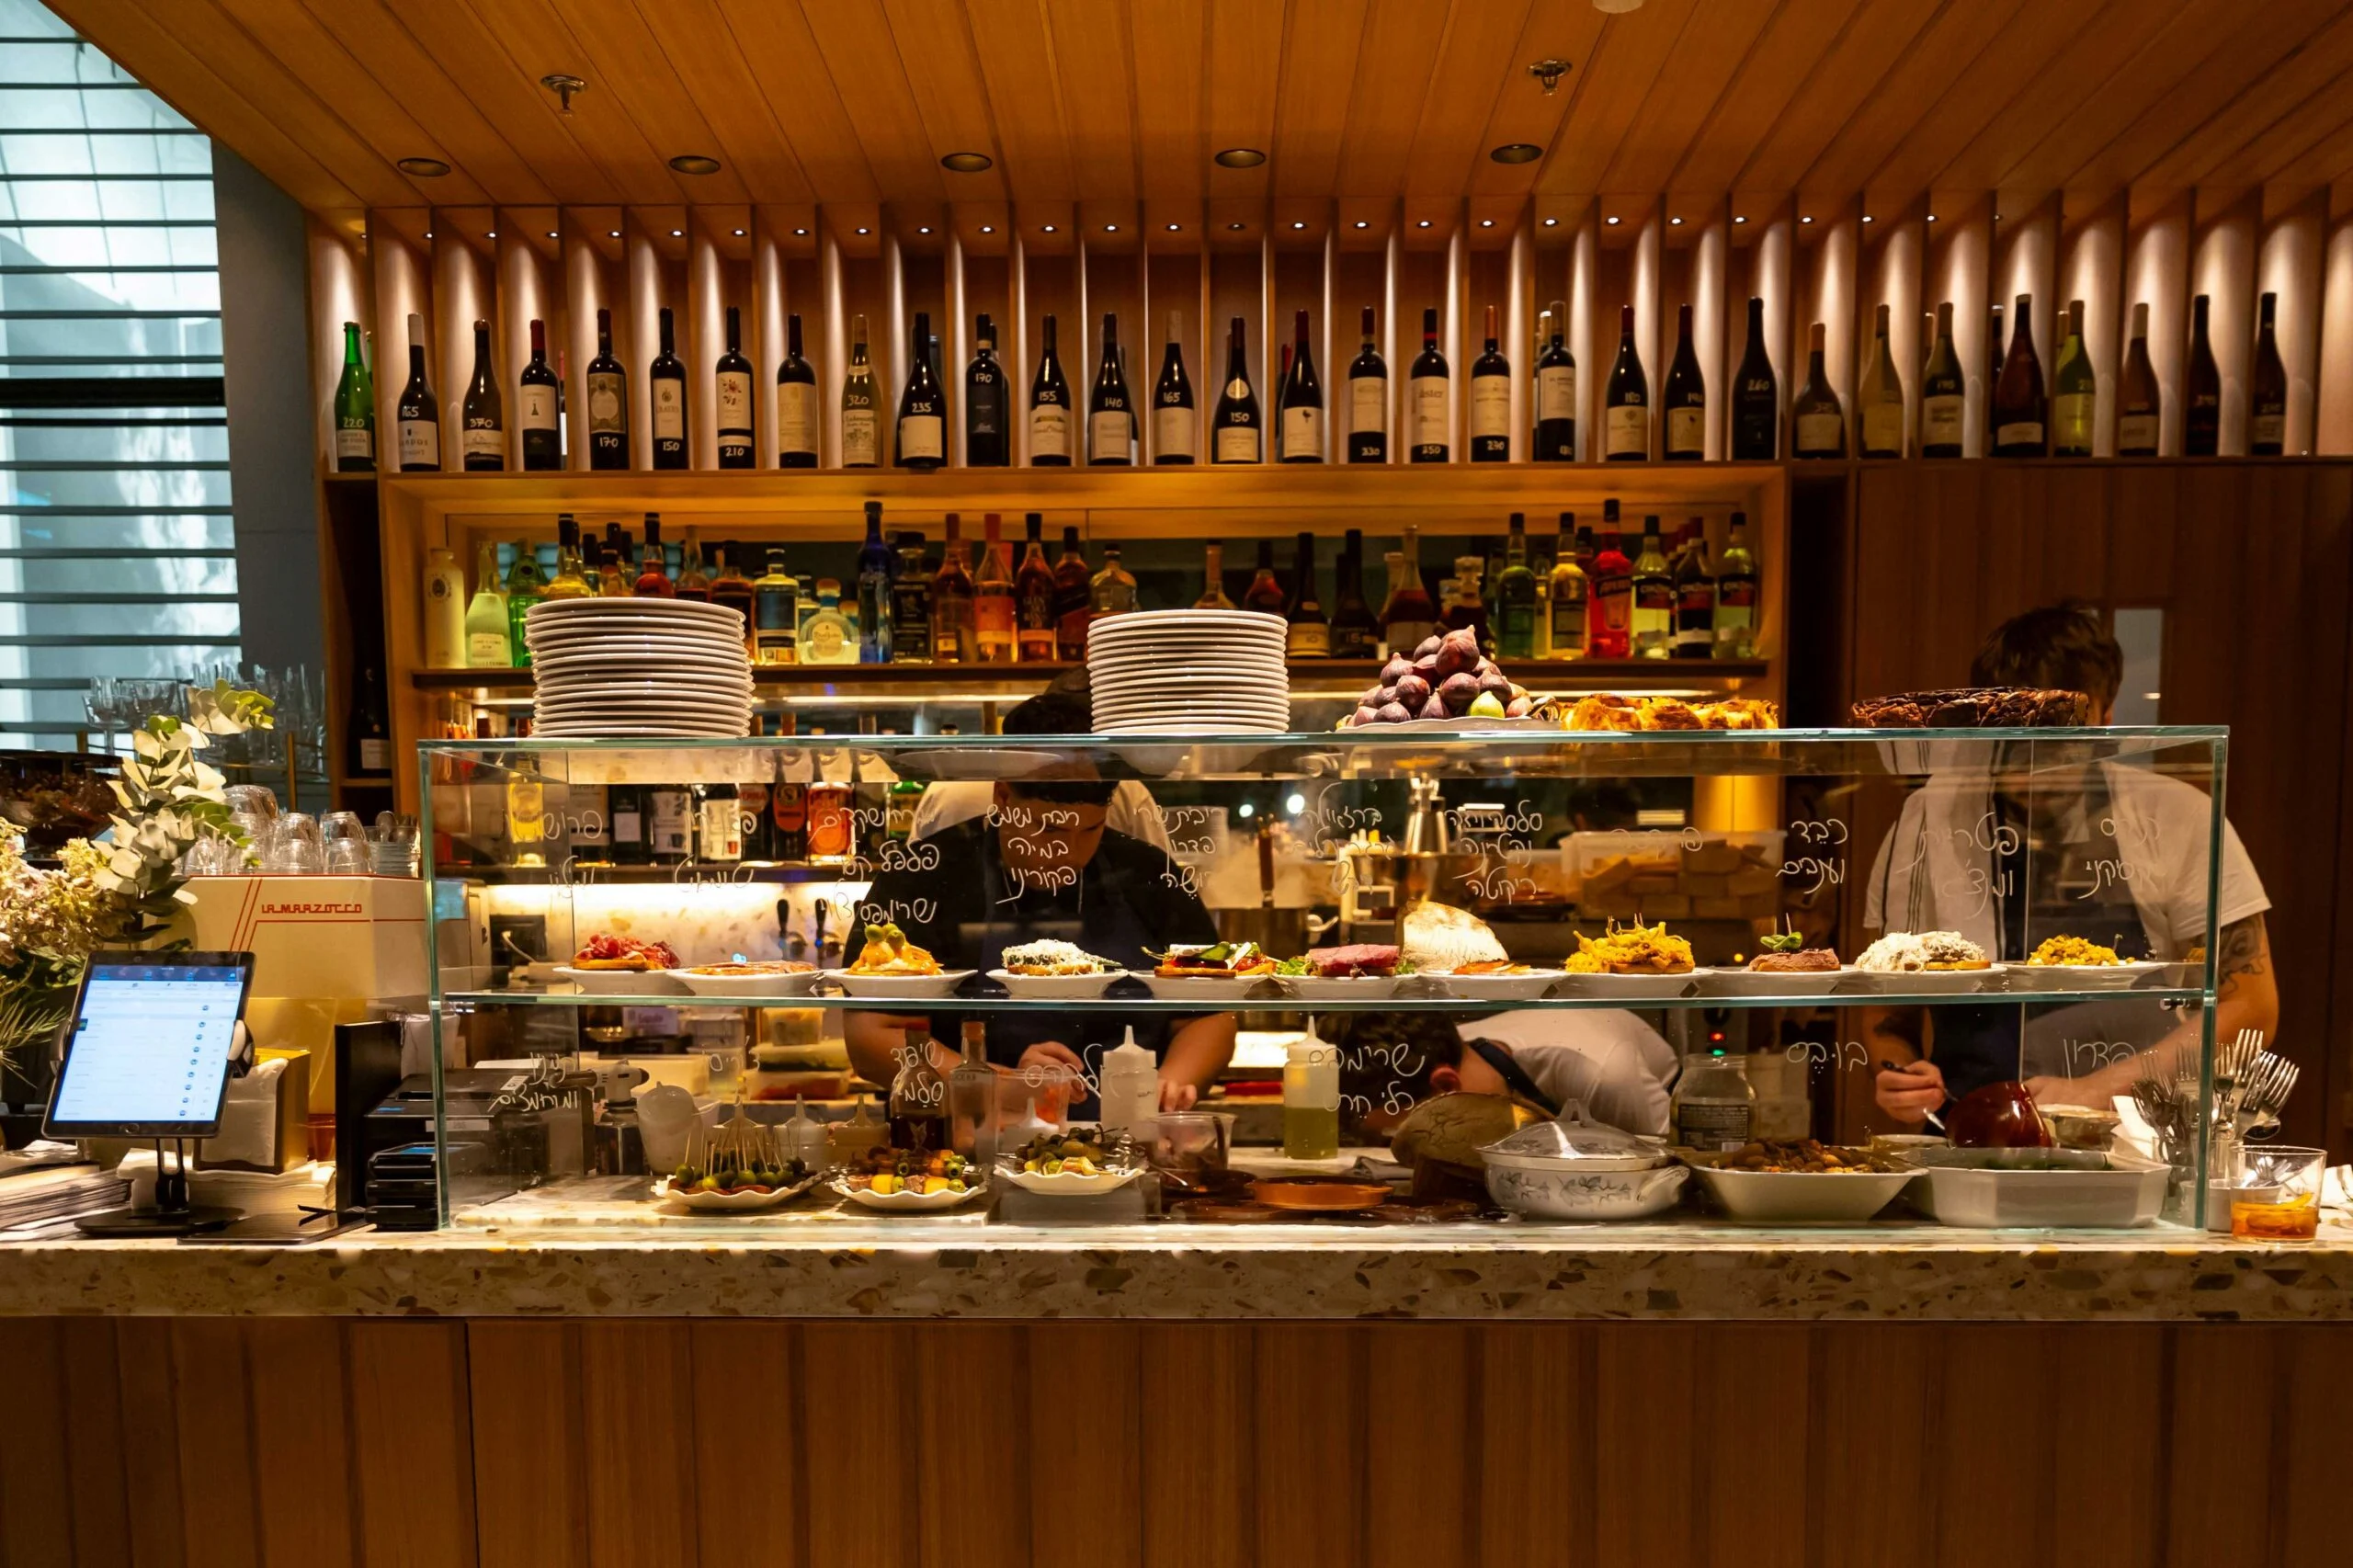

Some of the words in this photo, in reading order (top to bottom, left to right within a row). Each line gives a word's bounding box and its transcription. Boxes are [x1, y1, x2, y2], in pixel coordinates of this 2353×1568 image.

[847, 394, 869, 406] 320
[1039, 391, 1057, 402] 155
[1105, 396, 1123, 408] 140
[1163, 392, 1181, 403] 165
[343, 416, 365, 427] 220
[1231, 412, 1250, 423] 150
[599, 437, 619, 448] 170
[663, 440, 680, 451] 150
[725, 447, 745, 457] 210
[808, 806, 885, 844] שקדים
[986, 803, 1033, 829] משמש
[1488, 799, 1544, 833] סלסה
[1790, 818, 1848, 845] כבד
[1007, 835, 1070, 859] במיה
[1171, 835, 1216, 854] פדרו
[879, 838, 940, 872] פלפל
[994, 865, 1077, 905] פקורינו
[1464, 865, 1538, 906] ריקוטה
[261, 903, 275, 914] LA
[279, 903, 363, 914] MARZOCCO
[860, 897, 938, 925] שרימפס
[1308, 1042, 1427, 1077] שרימפס
